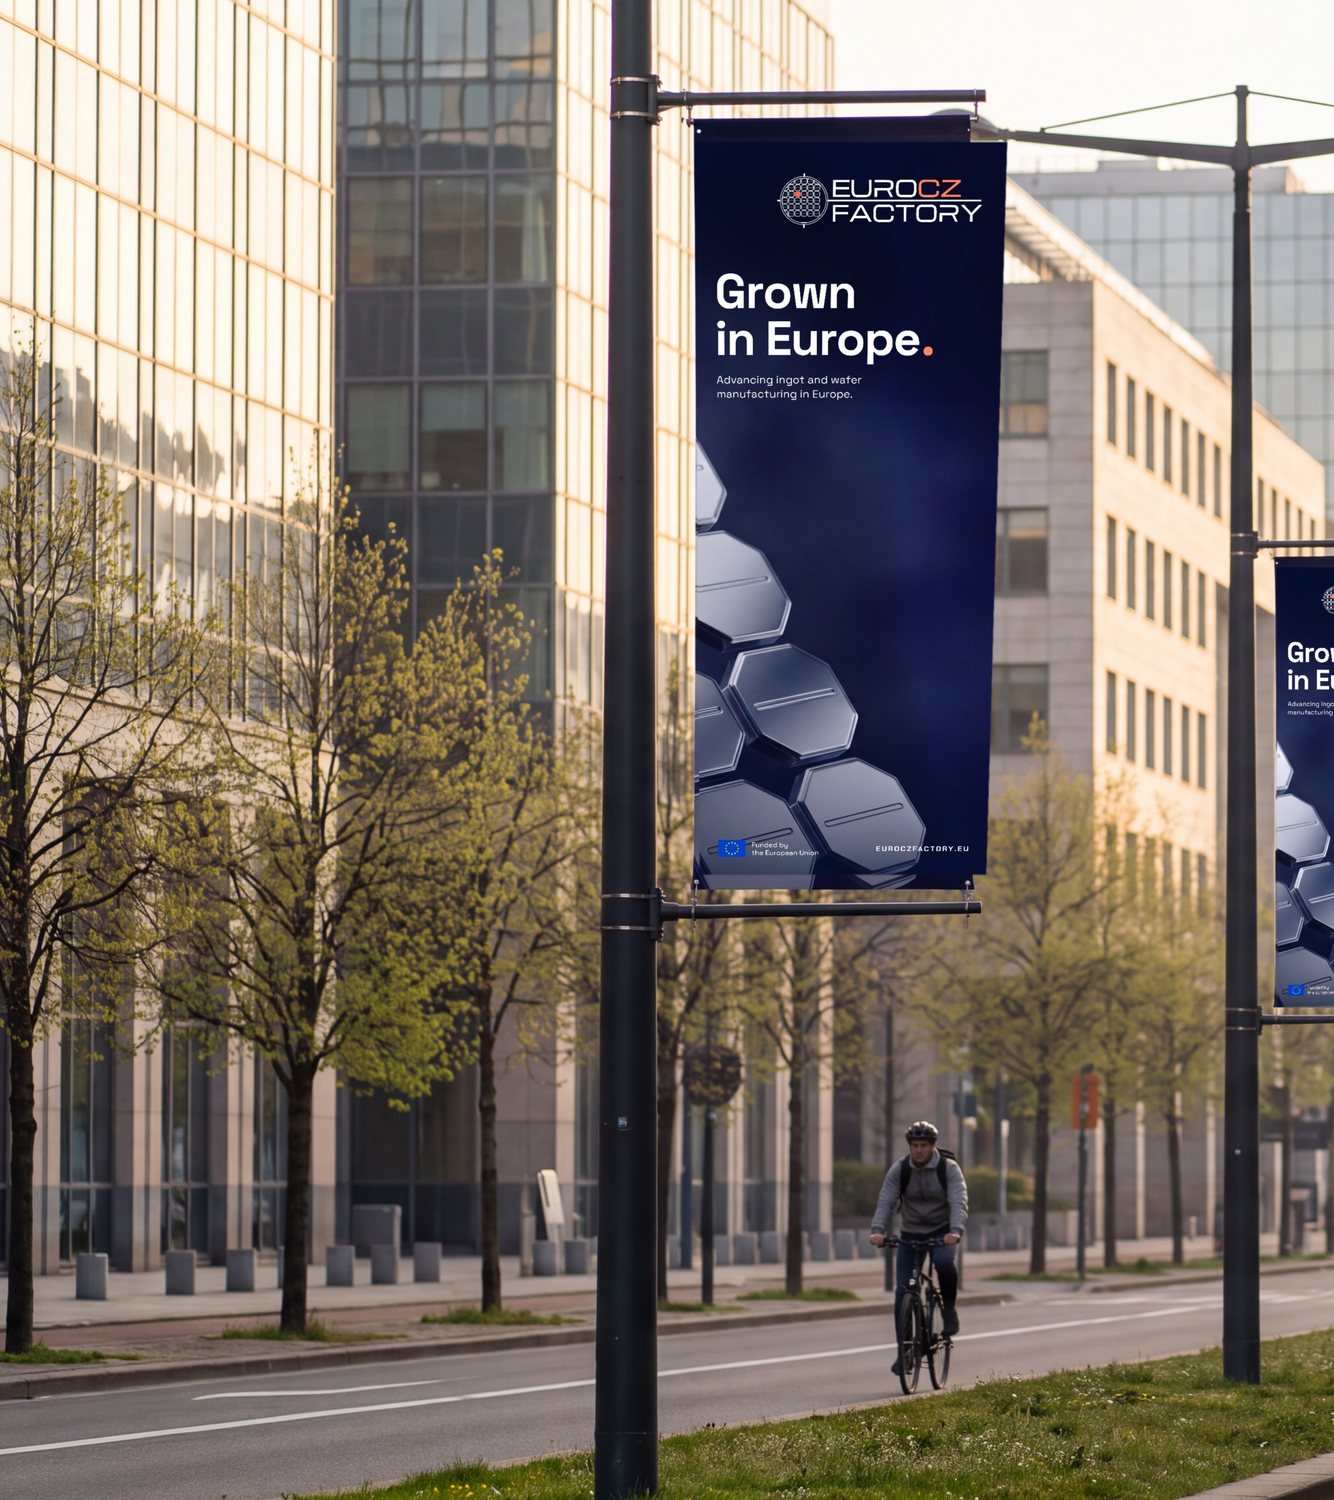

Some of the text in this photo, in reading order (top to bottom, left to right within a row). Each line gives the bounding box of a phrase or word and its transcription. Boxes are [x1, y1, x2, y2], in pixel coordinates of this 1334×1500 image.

[832, 179, 961, 198] EUROCZ
[832, 204, 982, 223] FACTORY
[717, 273, 855, 309] Grown
[717, 320, 933, 365] in Europe.
[717, 376, 862, 386] Advancing ingot and wafer
[717, 390, 853, 400] manufacturing in Europe.
[1288, 669, 1309, 690] in
